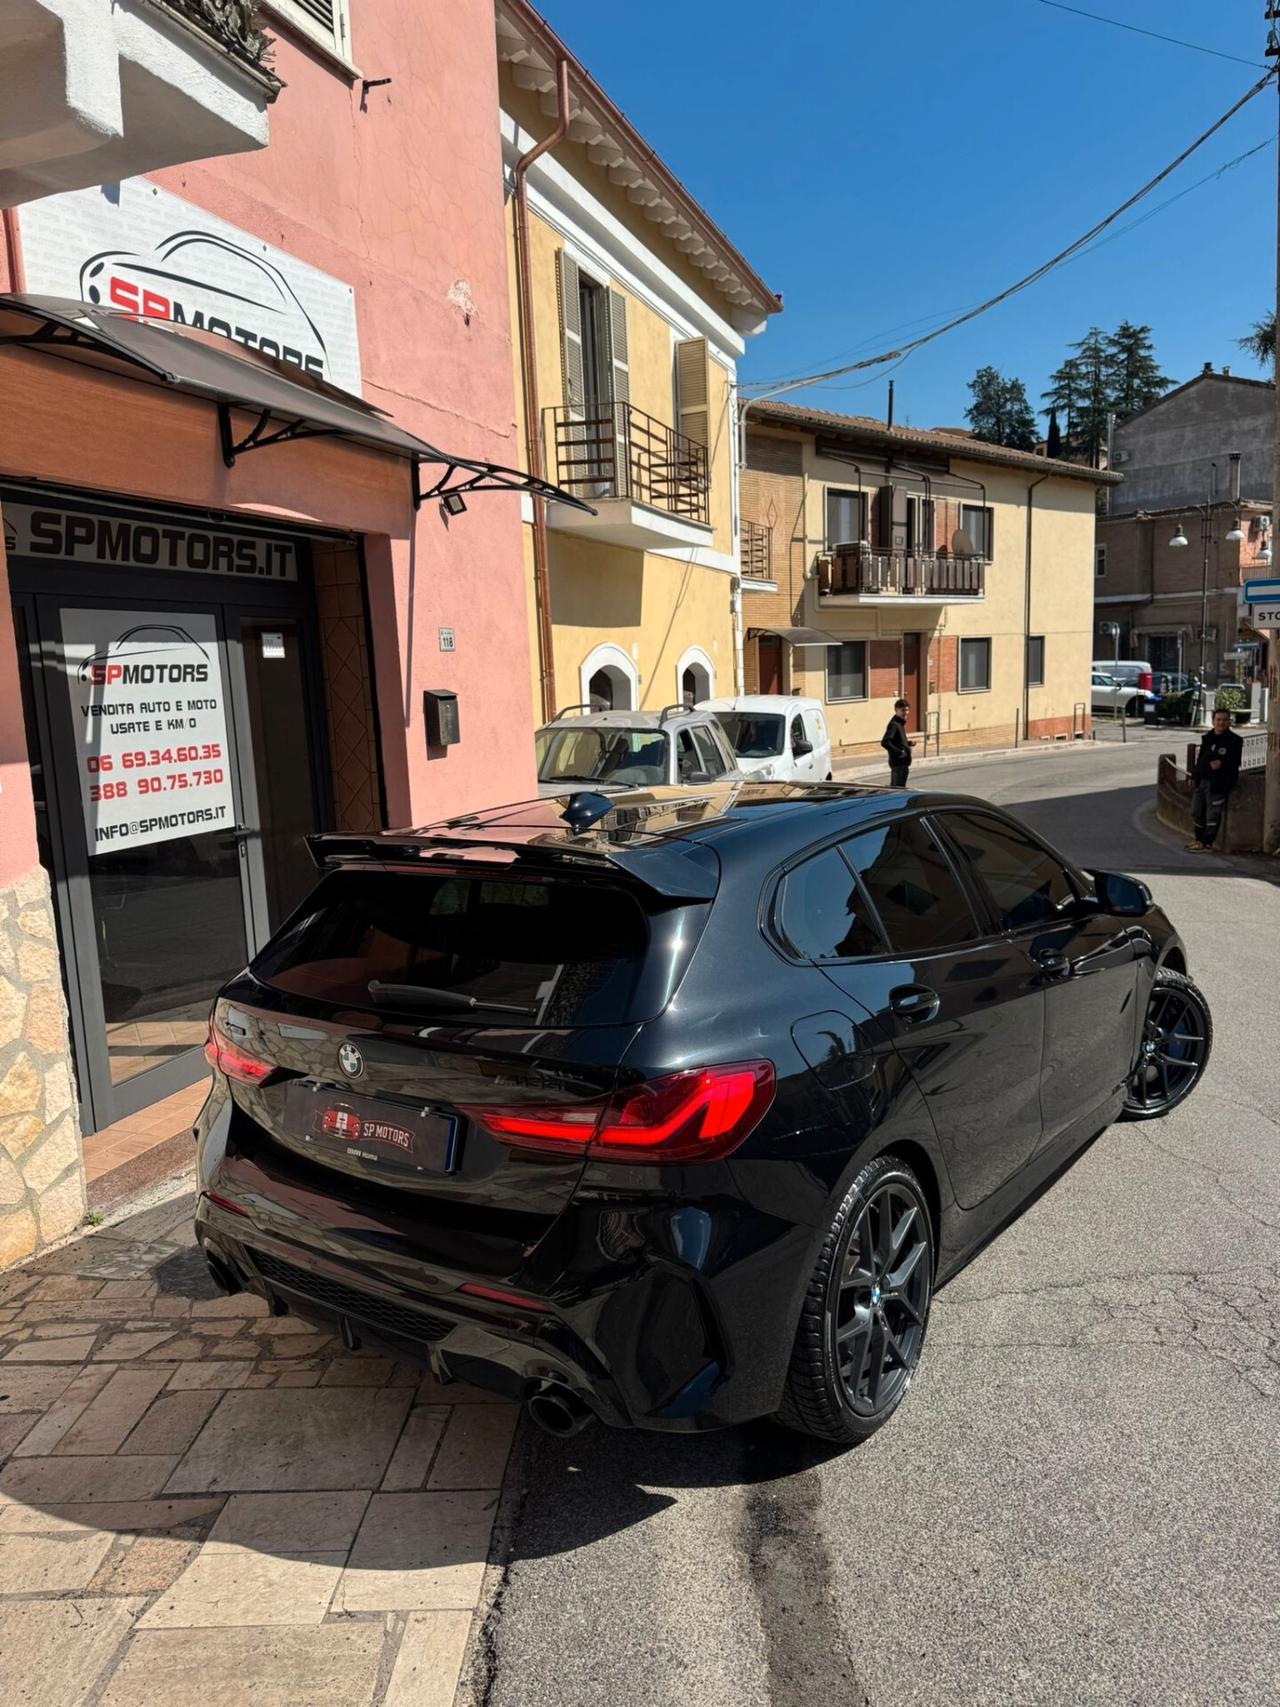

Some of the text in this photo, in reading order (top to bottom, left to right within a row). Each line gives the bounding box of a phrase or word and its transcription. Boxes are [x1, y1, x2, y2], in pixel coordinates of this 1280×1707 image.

[29, 510, 293, 578] SPMOTORS.IT
[443, 636, 453, 647] 118
[91, 663, 208, 686] SPMOTORS
[80, 699, 217, 717] VENDITA AUTO E MOTO
[110, 720, 150, 735] USATE
[155, 719, 163, 731] E
[86, 743, 222, 774] 06 69.34.60.35
[89, 768, 223, 802] 388 90.75.730
[95, 805, 227, 842] INFO@SPMOTORS.IT
[363, 1123, 410, 1147] SP MOTORS
